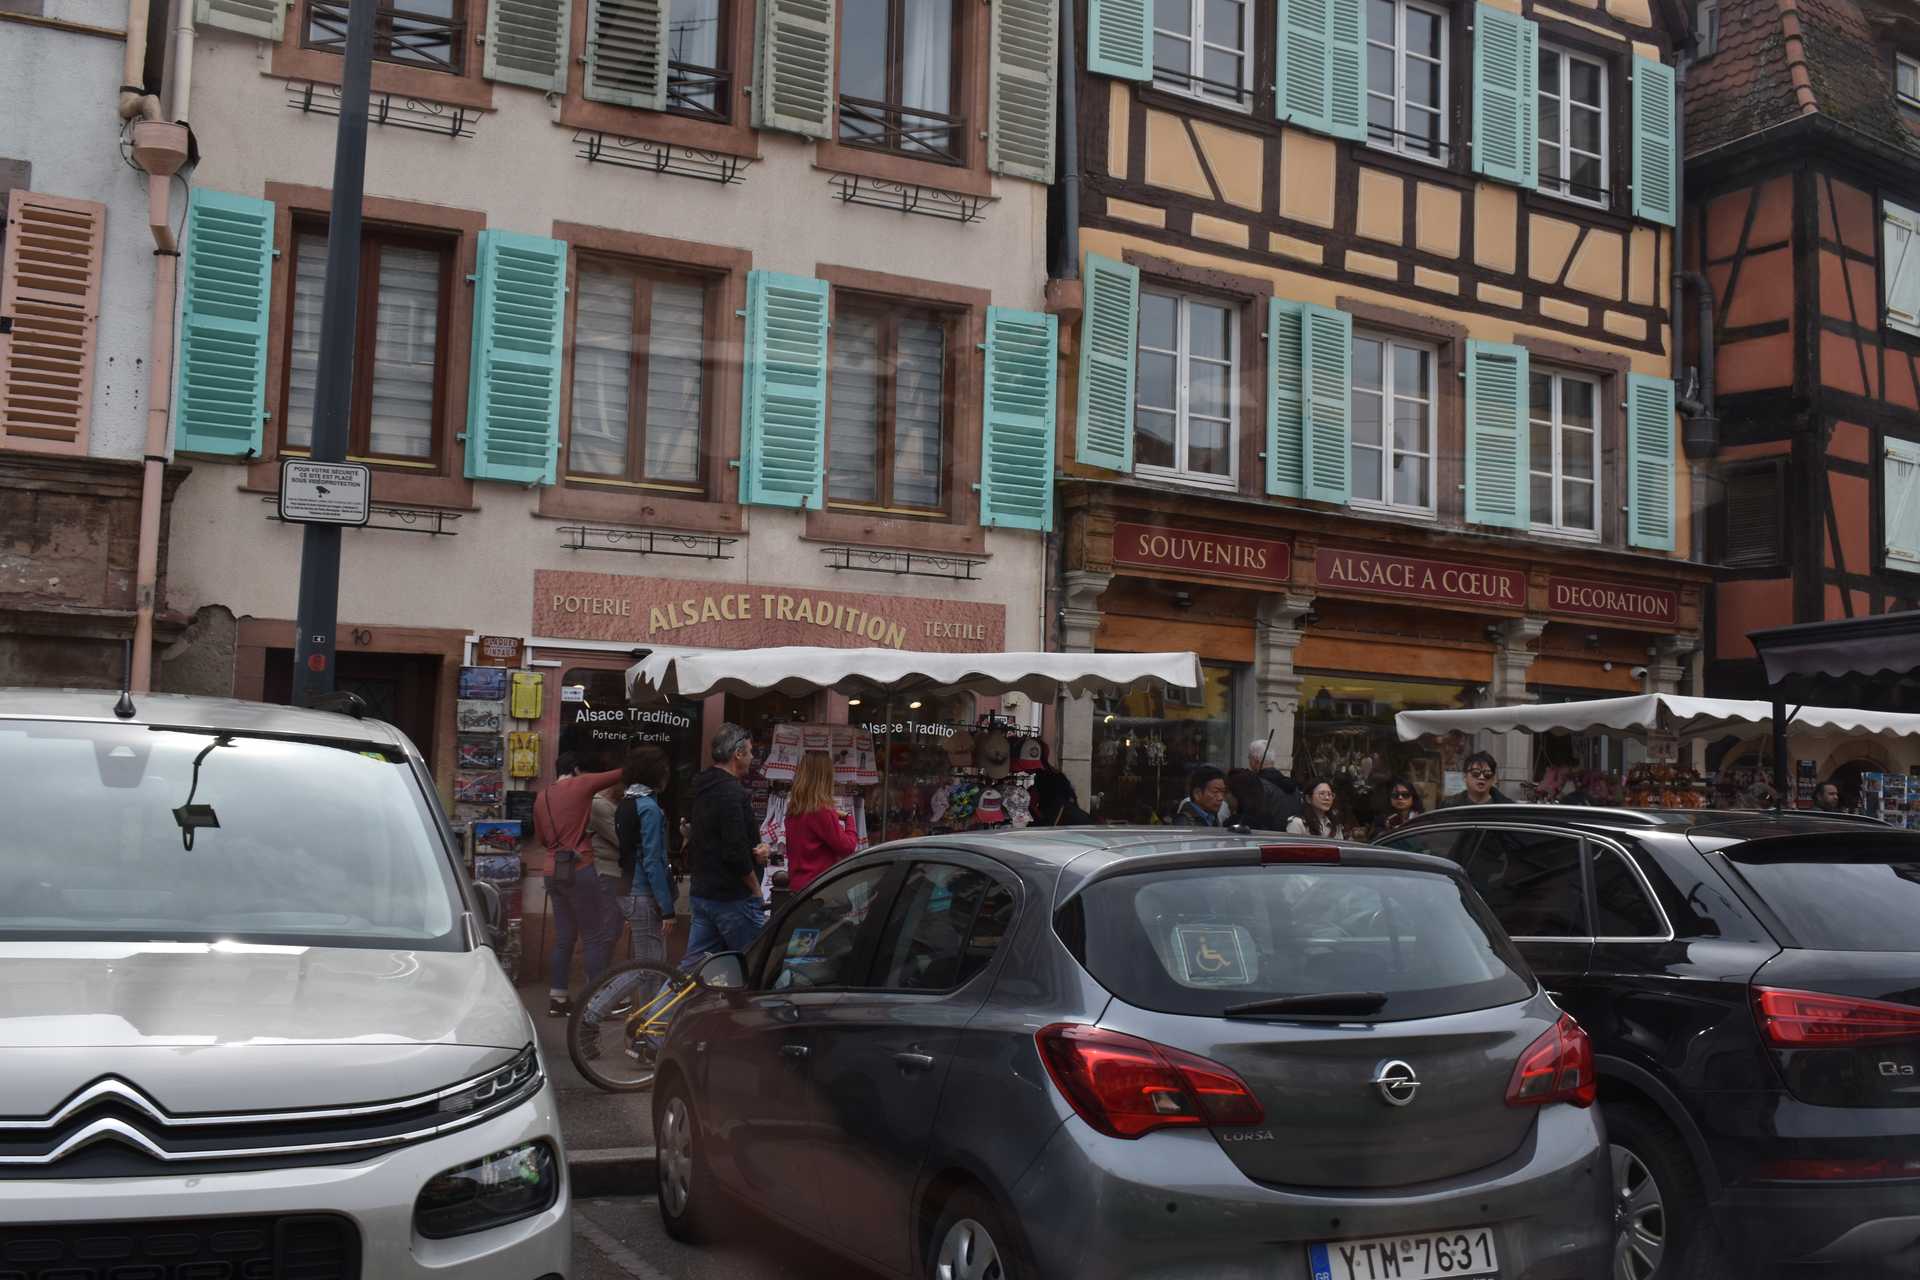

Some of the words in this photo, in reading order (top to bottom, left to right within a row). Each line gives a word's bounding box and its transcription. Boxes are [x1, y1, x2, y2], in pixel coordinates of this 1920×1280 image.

[1138, 534, 1267, 569] SOUVENIRS
[1329, 557, 1415, 588] ALSACE
[1421, 568, 1436, 590] A
[552, 595, 631, 616] POTERIE
[1556, 584, 1669, 616] DECORATION
[649, 593, 752, 634] ALSACE
[761, 593, 906, 649] TRADITION
[924, 621, 986, 640] TEXTILE
[575, 708, 624, 723] Alsace
[627, 707, 690, 728] Tradition
[592, 729, 627, 741] Poterie
[637, 731, 671, 742] Textile
[907, 721, 957, 738] Traditio
[1879, 1061, 1914, 1076] Q3
[1223, 1130, 1274, 1141] CORSA
[1339, 1232, 1492, 1280] YTM-7631
